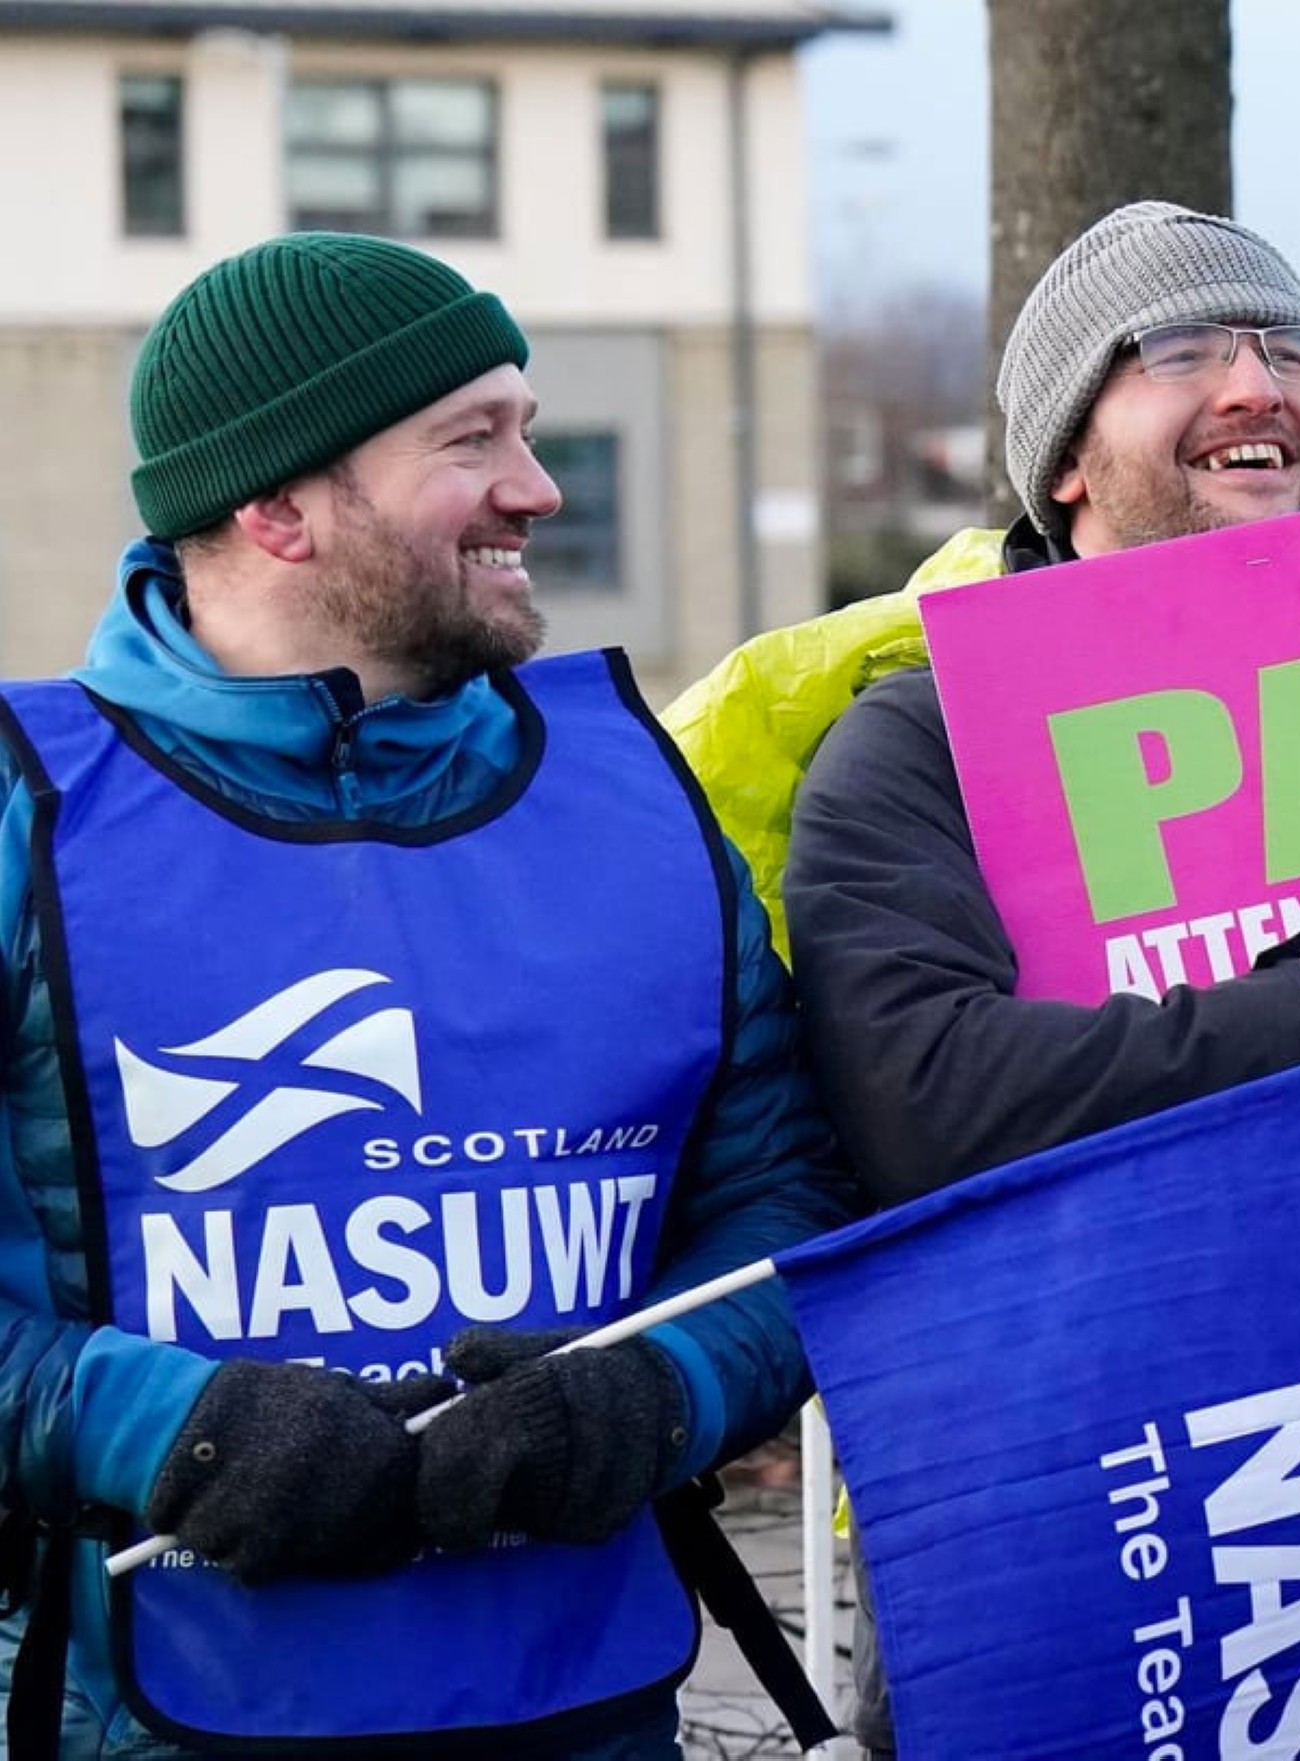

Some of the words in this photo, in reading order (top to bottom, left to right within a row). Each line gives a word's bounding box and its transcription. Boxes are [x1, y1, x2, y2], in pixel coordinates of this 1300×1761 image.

[362, 1123, 660, 1170] SCOTLAND
[140, 1174, 658, 1343] NASUWT
[1099, 1421, 1171, 1581] The
